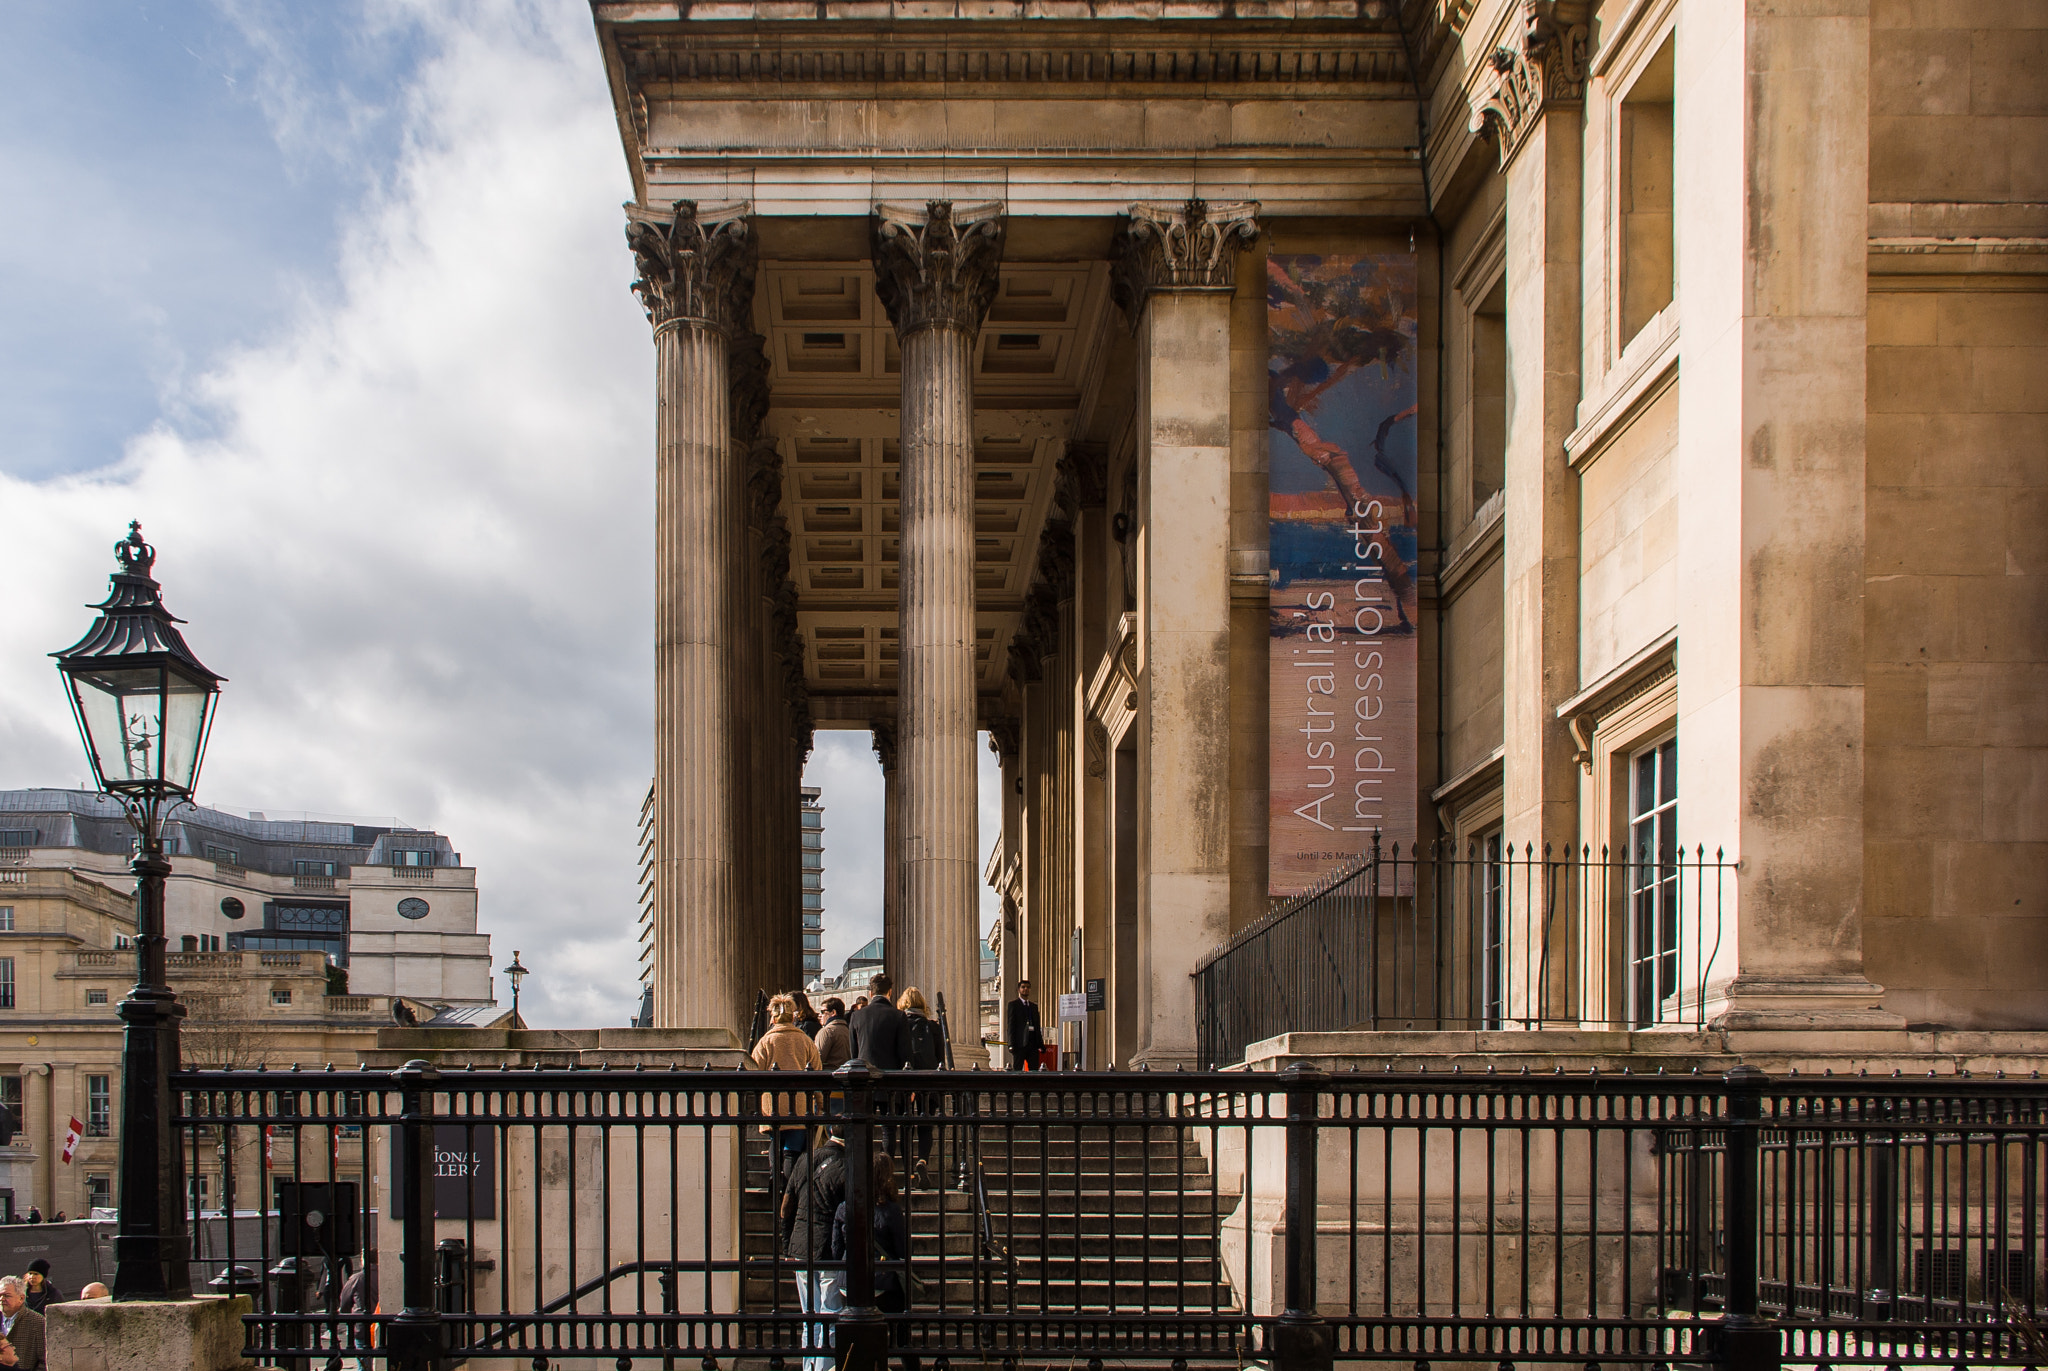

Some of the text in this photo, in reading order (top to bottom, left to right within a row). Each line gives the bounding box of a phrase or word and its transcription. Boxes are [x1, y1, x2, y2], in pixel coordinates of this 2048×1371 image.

[1293, 590, 1335, 832] Australia's
[1341, 499, 1396, 832] Impressionists
[1296, 851, 1319, 860] Until
[1321, 851, 1333, 860] 26
[434, 1164, 481, 1176] LERY
